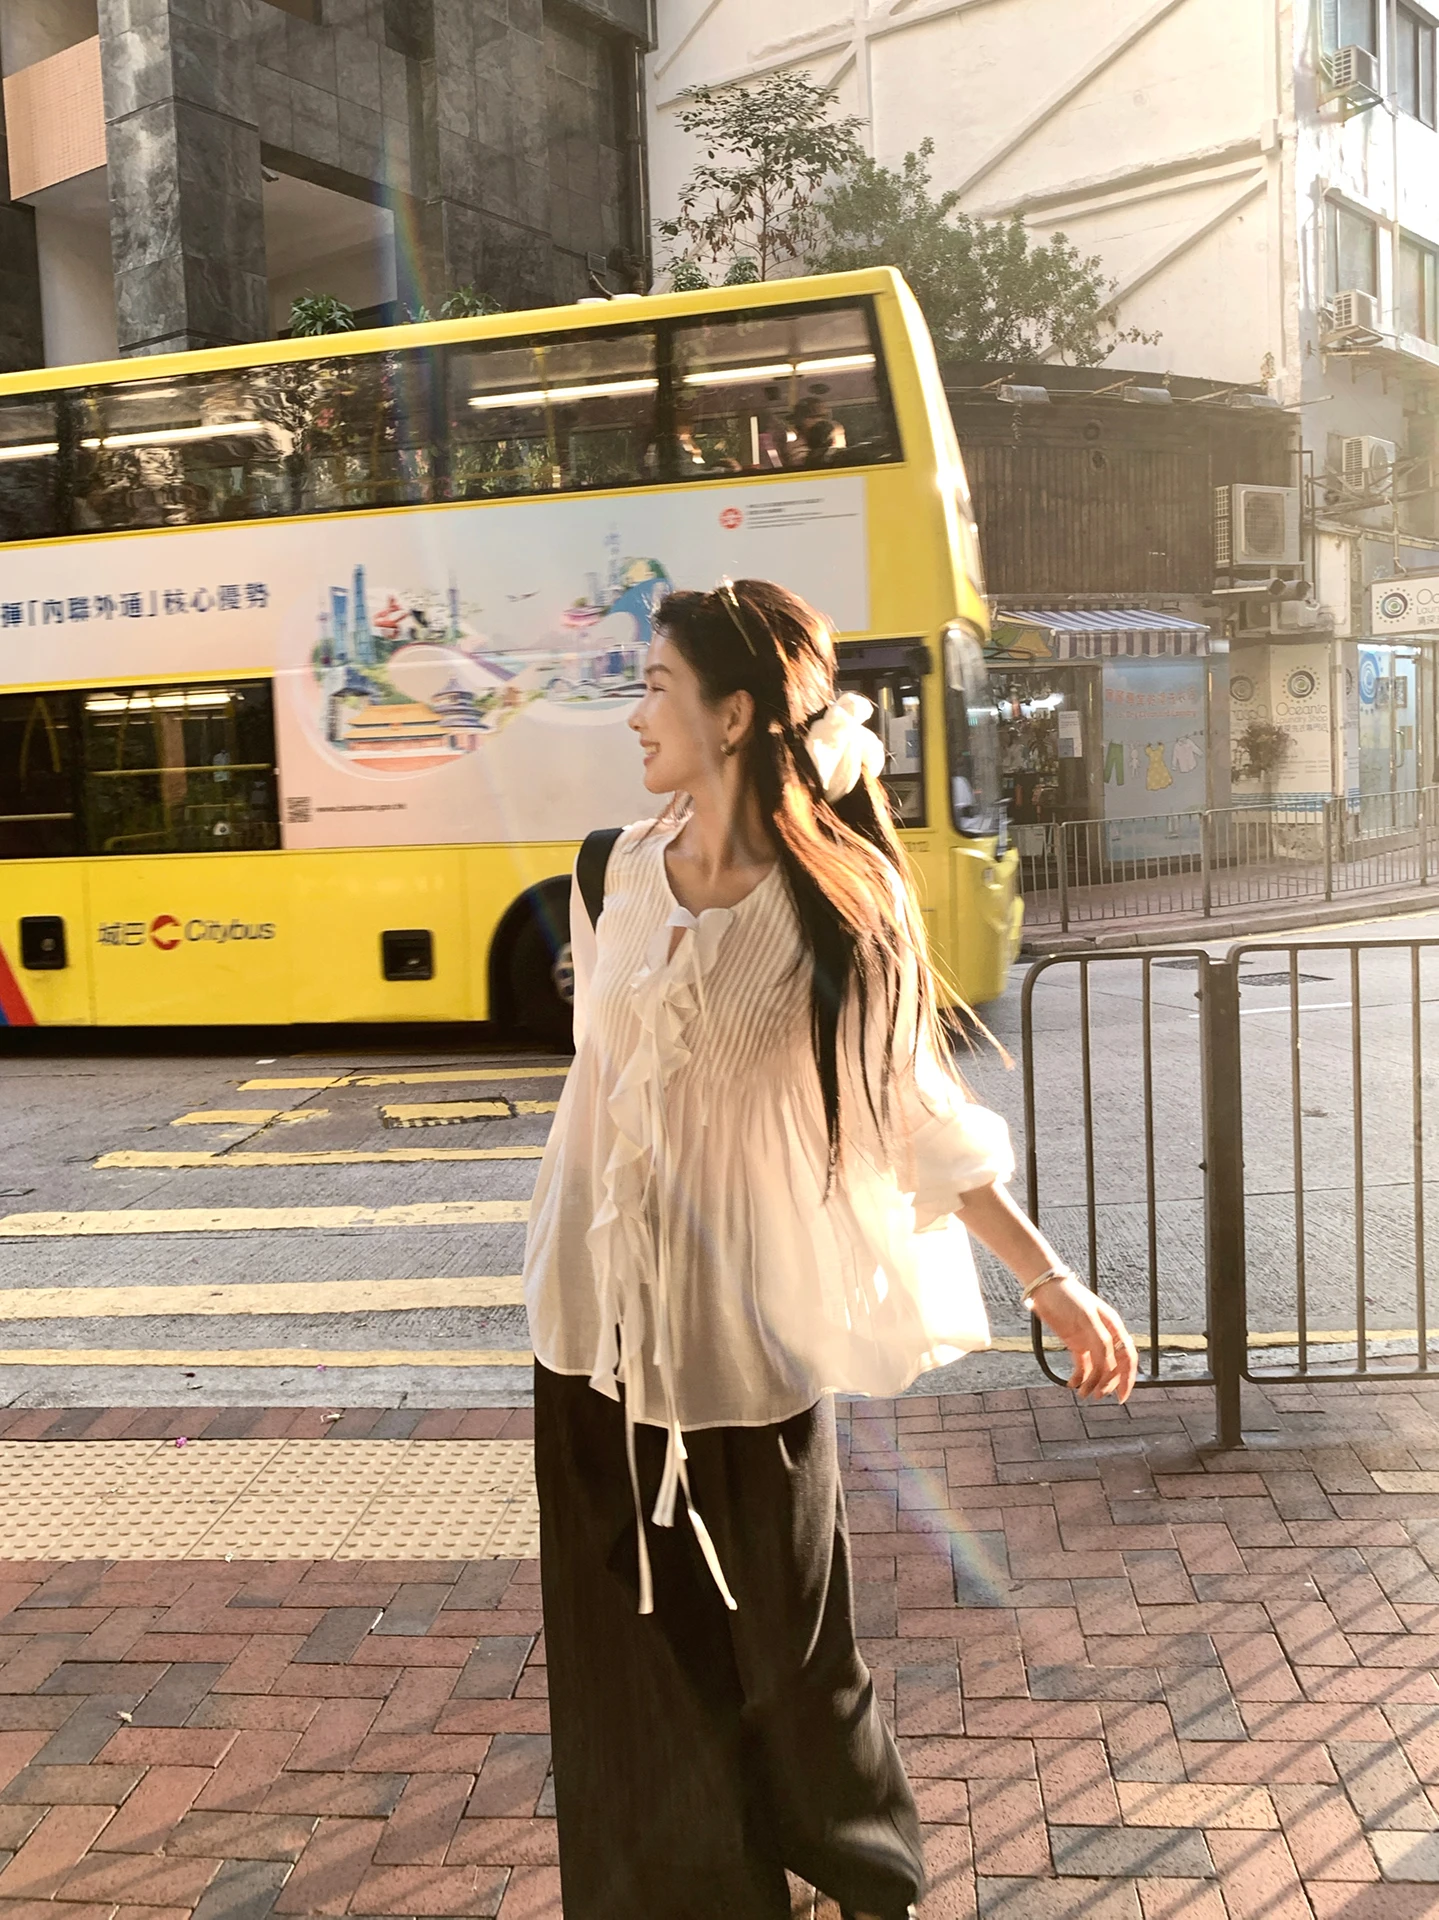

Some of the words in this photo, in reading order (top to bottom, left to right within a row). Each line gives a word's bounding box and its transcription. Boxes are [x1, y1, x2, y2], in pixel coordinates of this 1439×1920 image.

[1276, 702, 1328, 716] Oceanic
[1308, 715, 1328, 723] Shop
[96, 922, 147, 946] 城巴
[185, 917, 276, 943] Citybus
